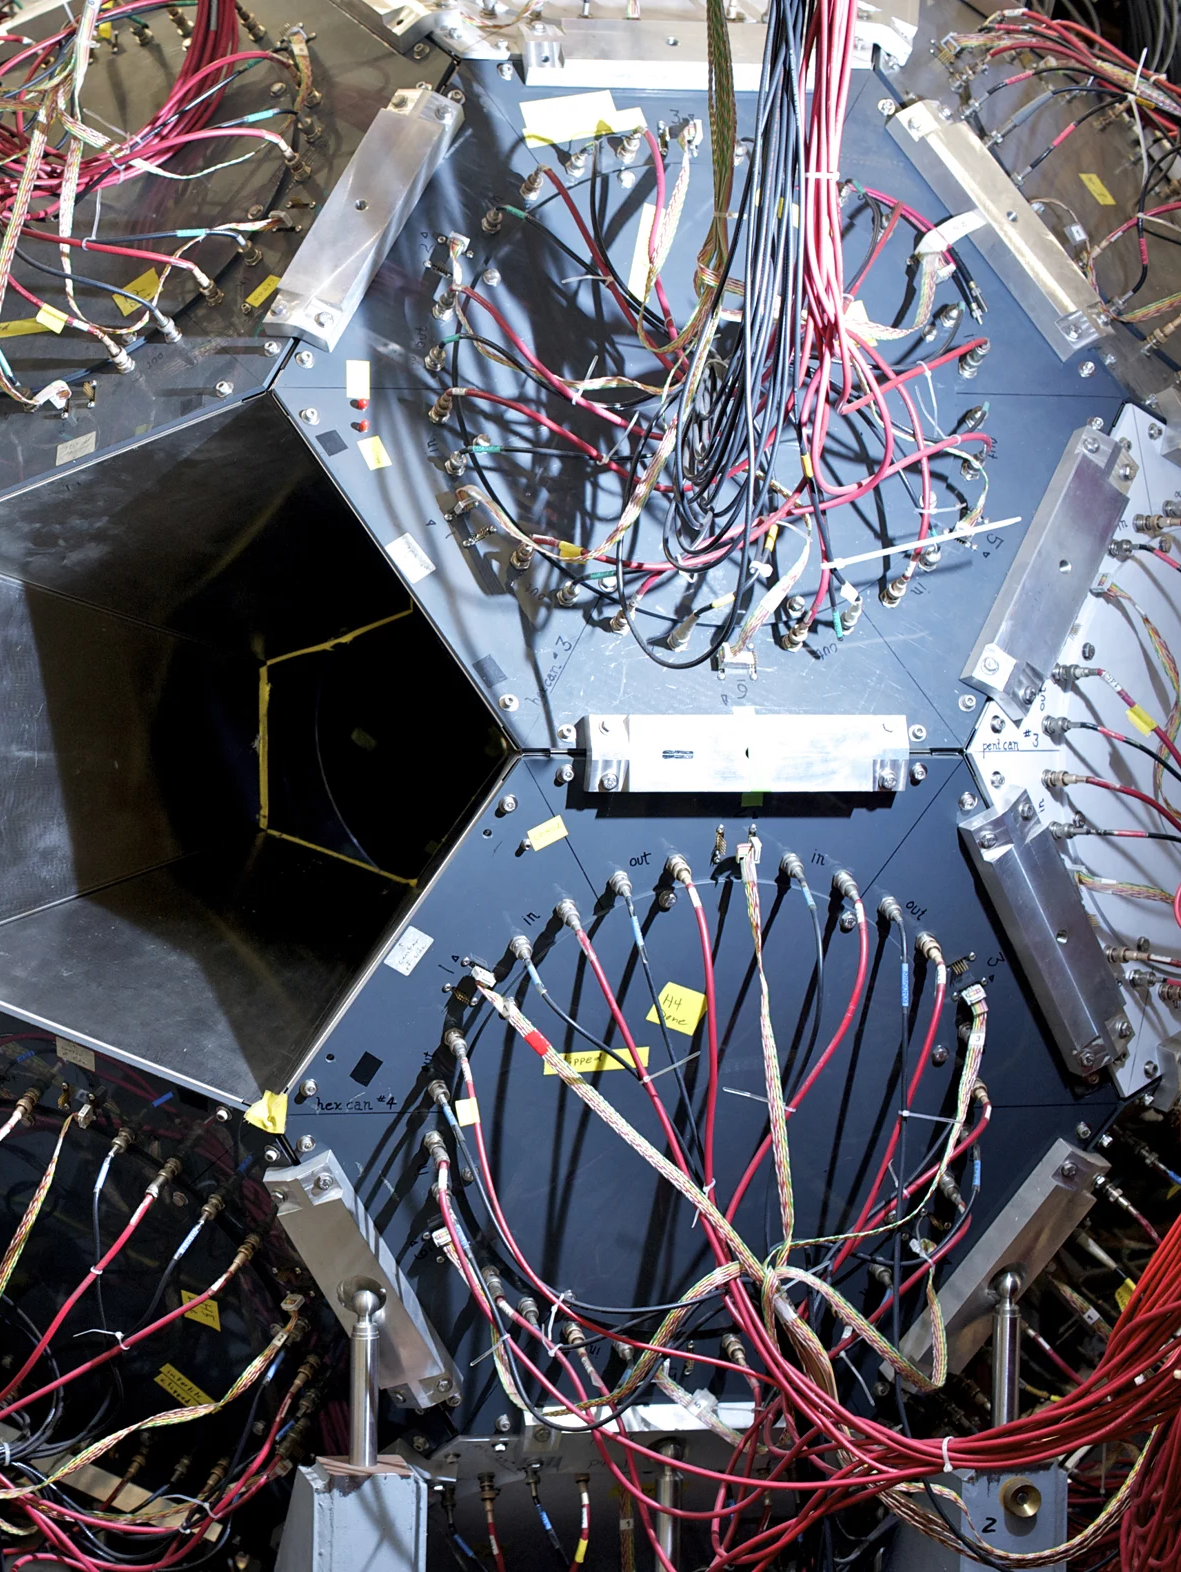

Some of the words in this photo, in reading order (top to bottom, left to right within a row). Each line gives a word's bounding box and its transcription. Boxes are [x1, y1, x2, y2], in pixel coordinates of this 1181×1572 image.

[986, 533, 1004, 549] 5
[910, 582, 931, 595] in
[982, 739, 1000, 759] pent
[1002, 740, 1019, 751] can
[629, 851, 651, 867] out
[810, 849, 825, 866] in
[522, 911, 541, 926] in
[905, 900, 928, 921] out
[987, 952, 1005, 968] 3
[662, 993, 683, 1011] H4
[975, 1033, 981, 1043] 3
[317, 1096, 342, 1111] hex
[345, 1100, 373, 1111] can
[376, 1096, 397, 1110] #4
[695, 1400, 702, 1409] 5
[626, 1519, 631, 1528] 1
[981, 1516, 997, 1533] 2
